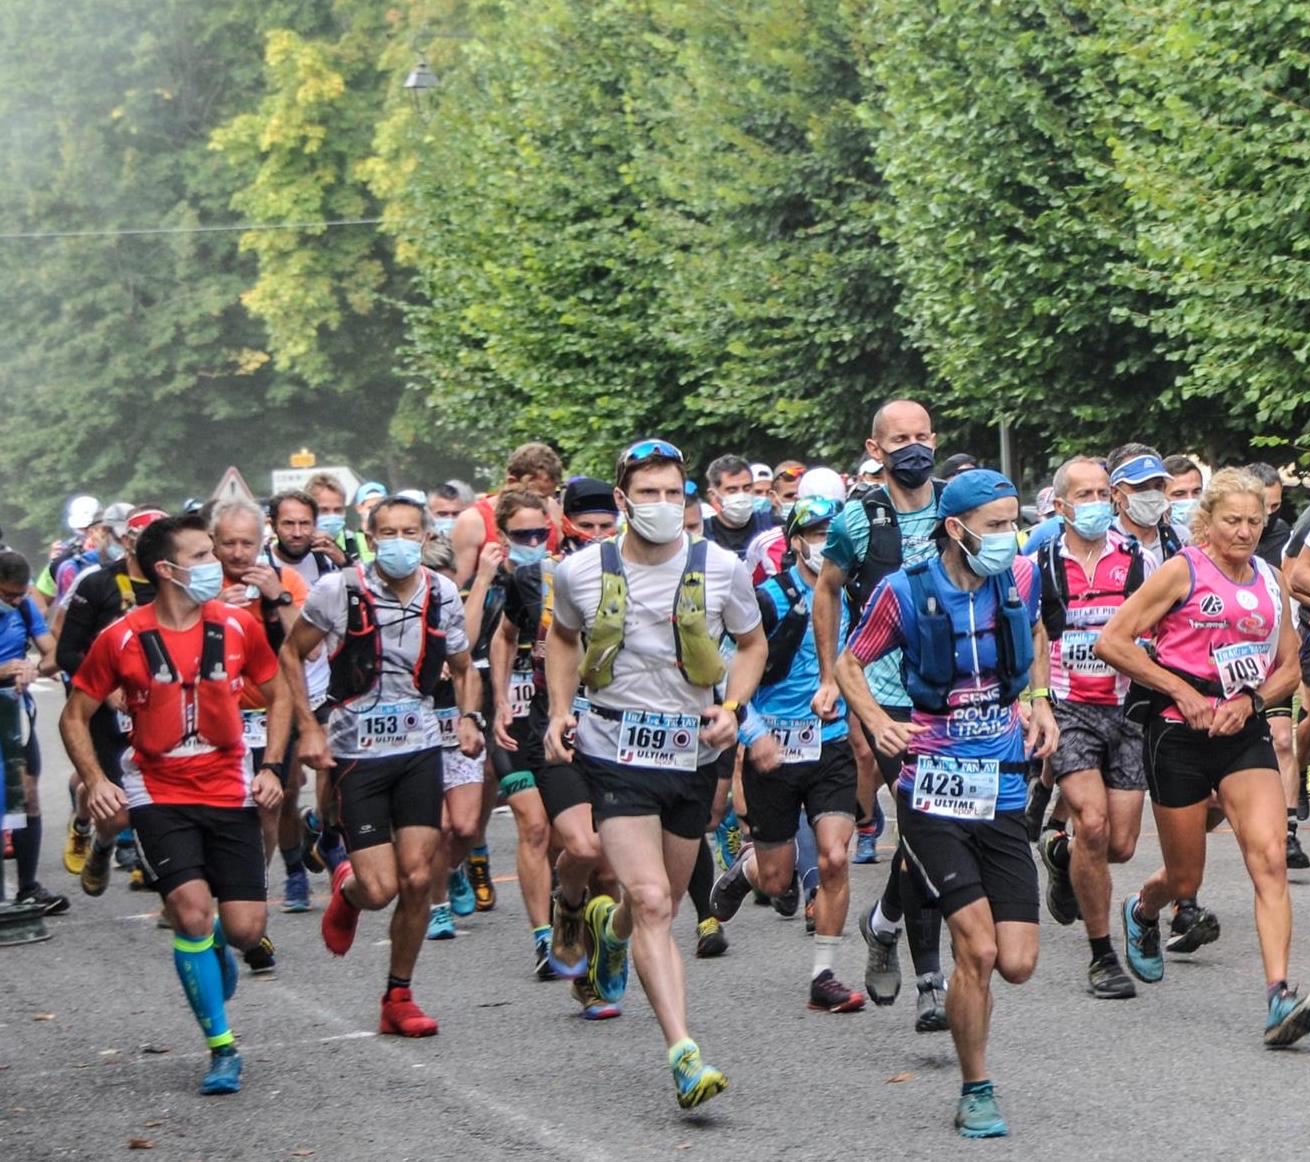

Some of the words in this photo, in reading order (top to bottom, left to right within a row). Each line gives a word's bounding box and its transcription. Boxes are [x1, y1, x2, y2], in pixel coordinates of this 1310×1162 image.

[1224, 657, 1260, 683] 109
[364, 715, 398, 735] 153
[627, 725, 667, 750] 169
[637, 749, 676, 762] ULTIME
[961, 761, 997, 774] TANAY
[920, 771, 965, 798] 423
[934, 799, 976, 809] ULTIME
